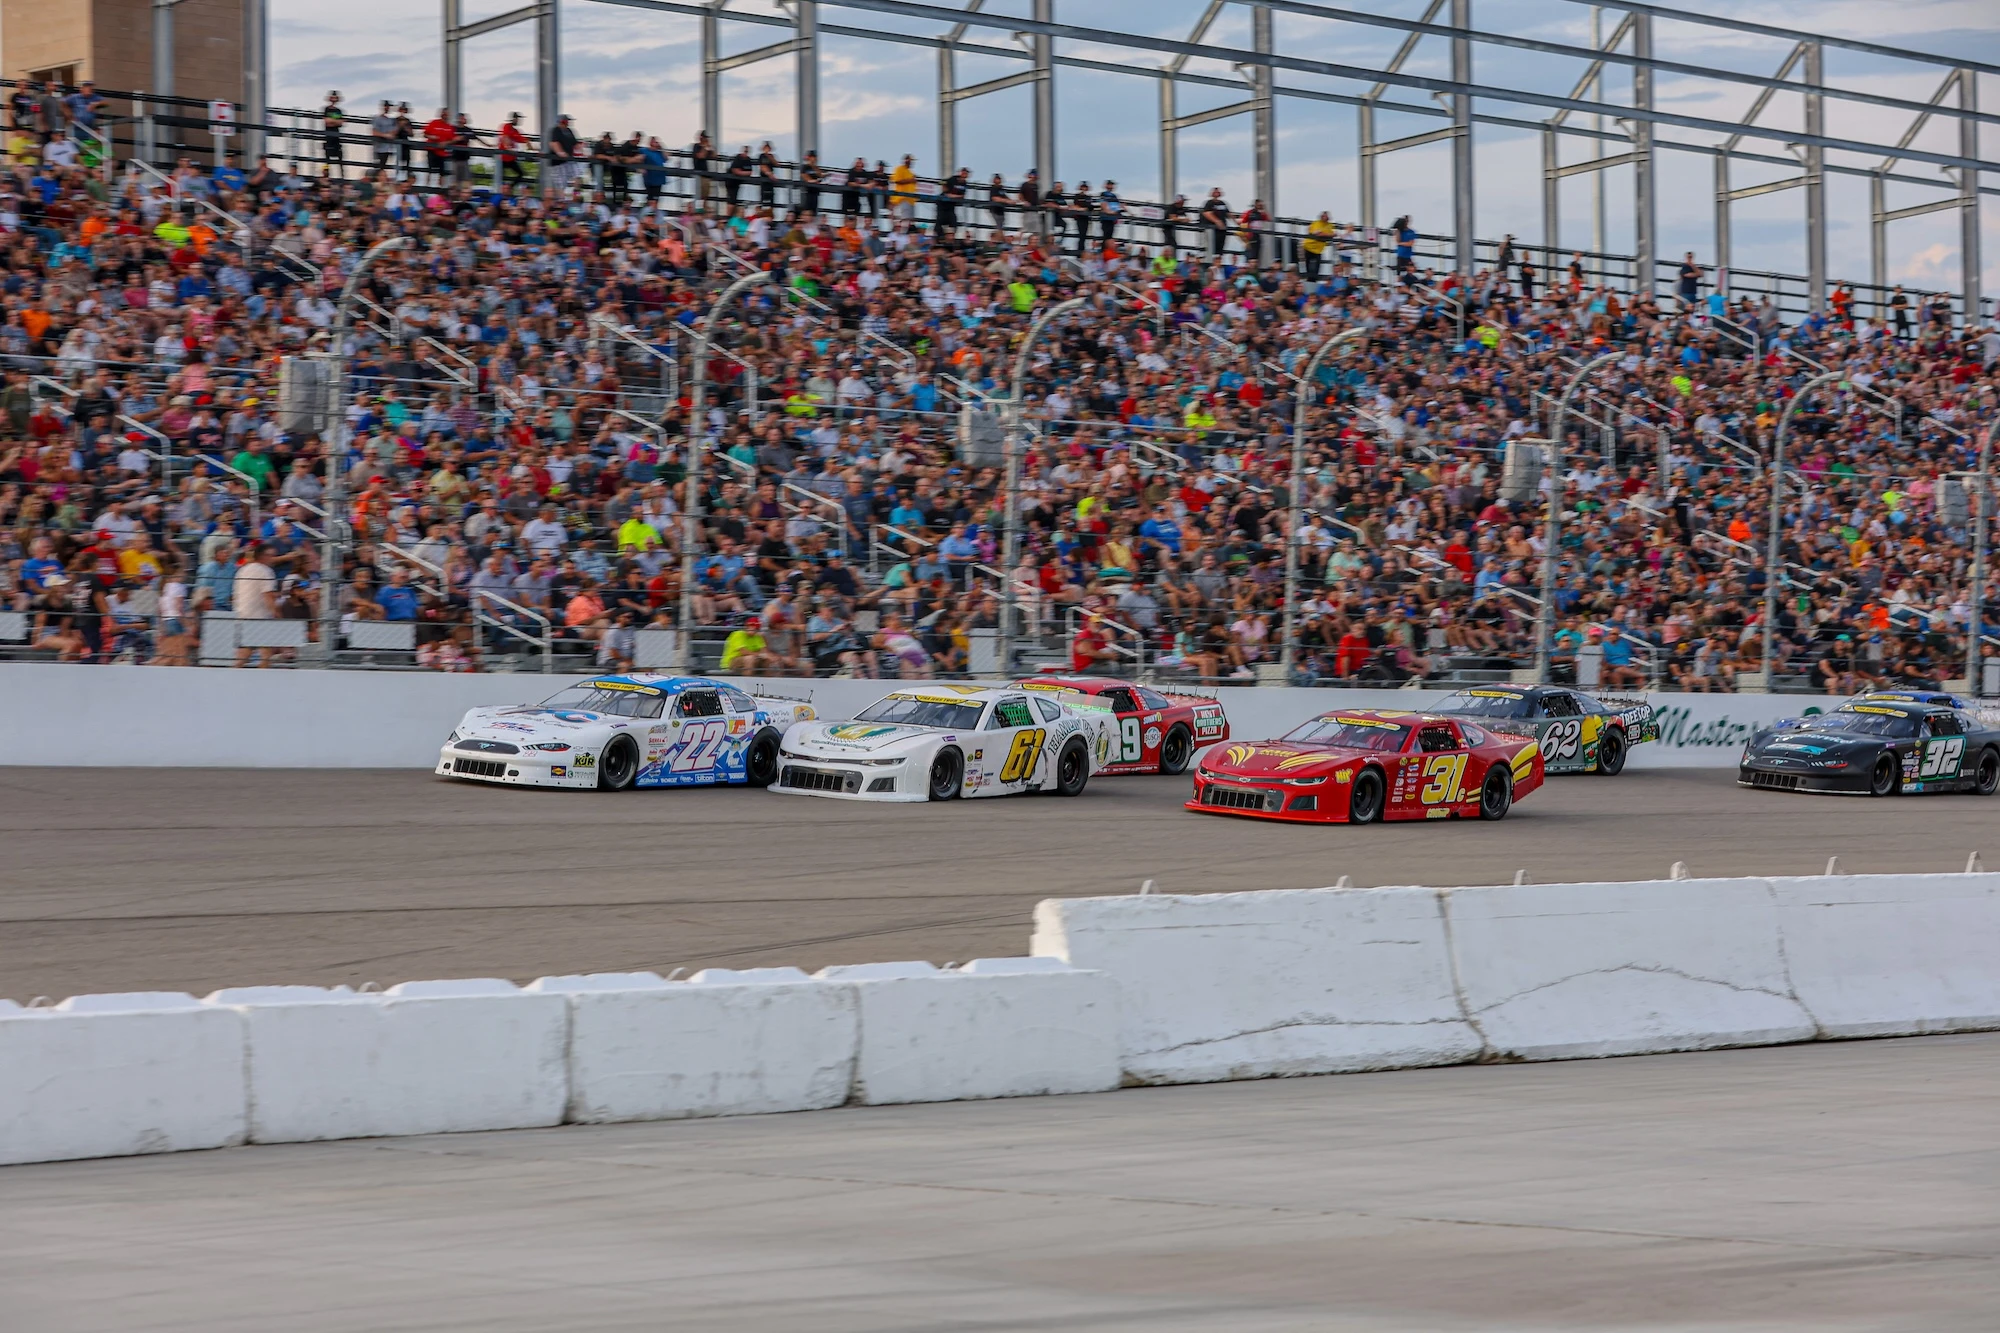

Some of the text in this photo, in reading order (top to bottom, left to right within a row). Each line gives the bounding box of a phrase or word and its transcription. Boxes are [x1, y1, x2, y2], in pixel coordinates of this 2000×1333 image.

[671, 721, 726, 772] 22
[1000, 728, 1047, 783] 61
[1118, 716, 1142, 763] 9
[1539, 720, 1582, 762] 62
